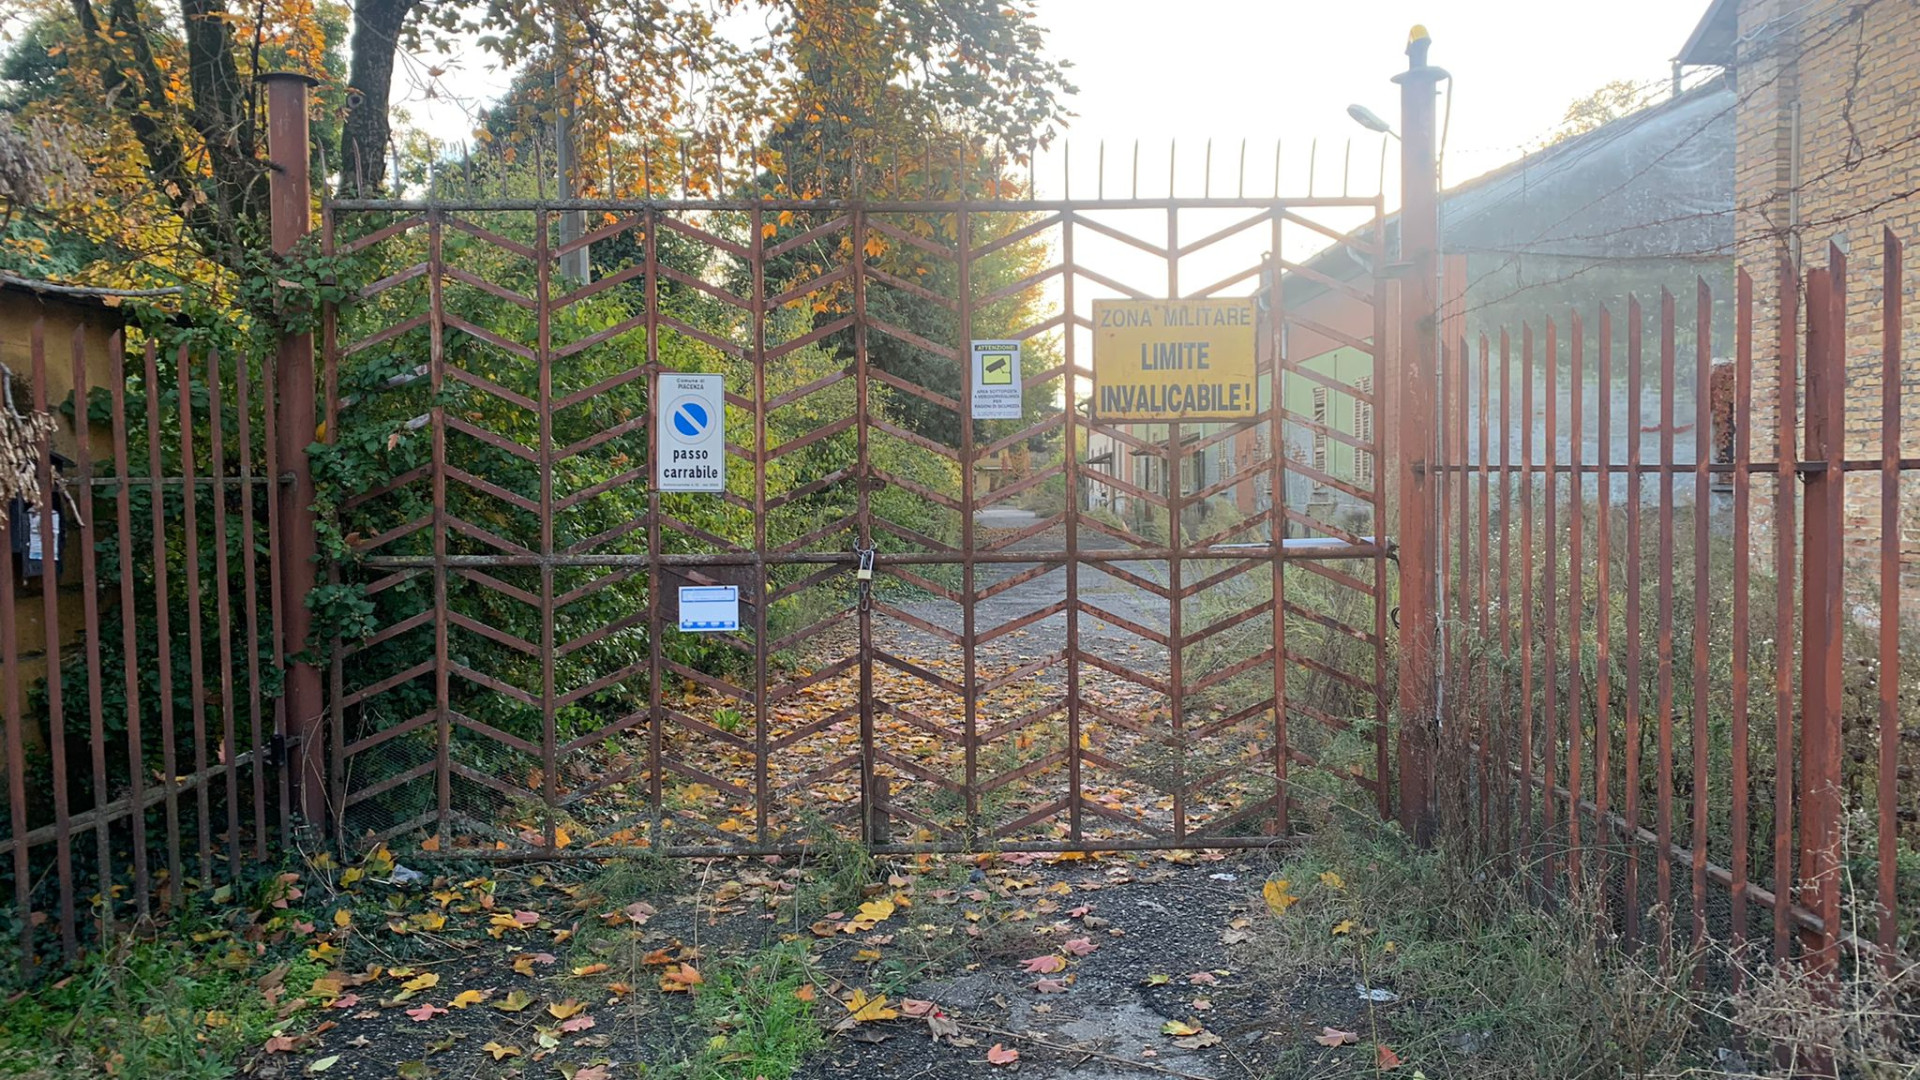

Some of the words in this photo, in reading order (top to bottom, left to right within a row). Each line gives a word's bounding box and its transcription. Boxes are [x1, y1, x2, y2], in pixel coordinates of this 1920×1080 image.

[1101, 309, 1152, 327] ZONA
[1164, 307, 1250, 326] MILITARE
[1141, 342, 1210, 371] LIMITE
[1101, 384, 1250, 412] INVALICABILE!
[673, 449, 709, 463] passo
[663, 465, 719, 479] carrabile
